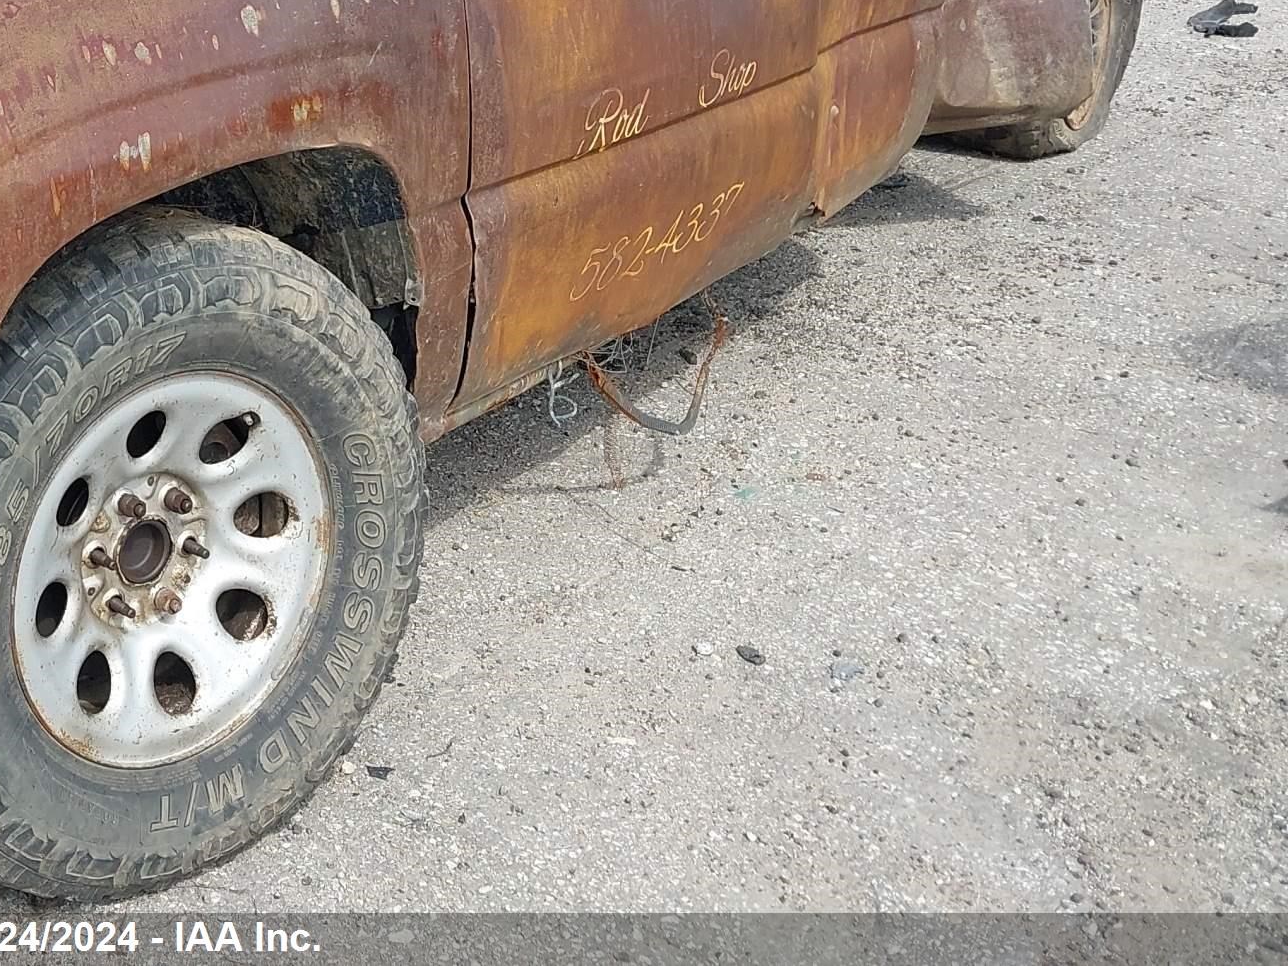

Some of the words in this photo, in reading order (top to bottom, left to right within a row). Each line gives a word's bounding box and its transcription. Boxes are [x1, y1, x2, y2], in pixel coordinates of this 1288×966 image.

[572, 87, 651, 160] Rod
[698, 47, 758, 108] Shop
[569, 181, 745, 302] 582-4337
[257, 432, 387, 775] CROSSWIND
[149, 761, 246, 832] M/T
